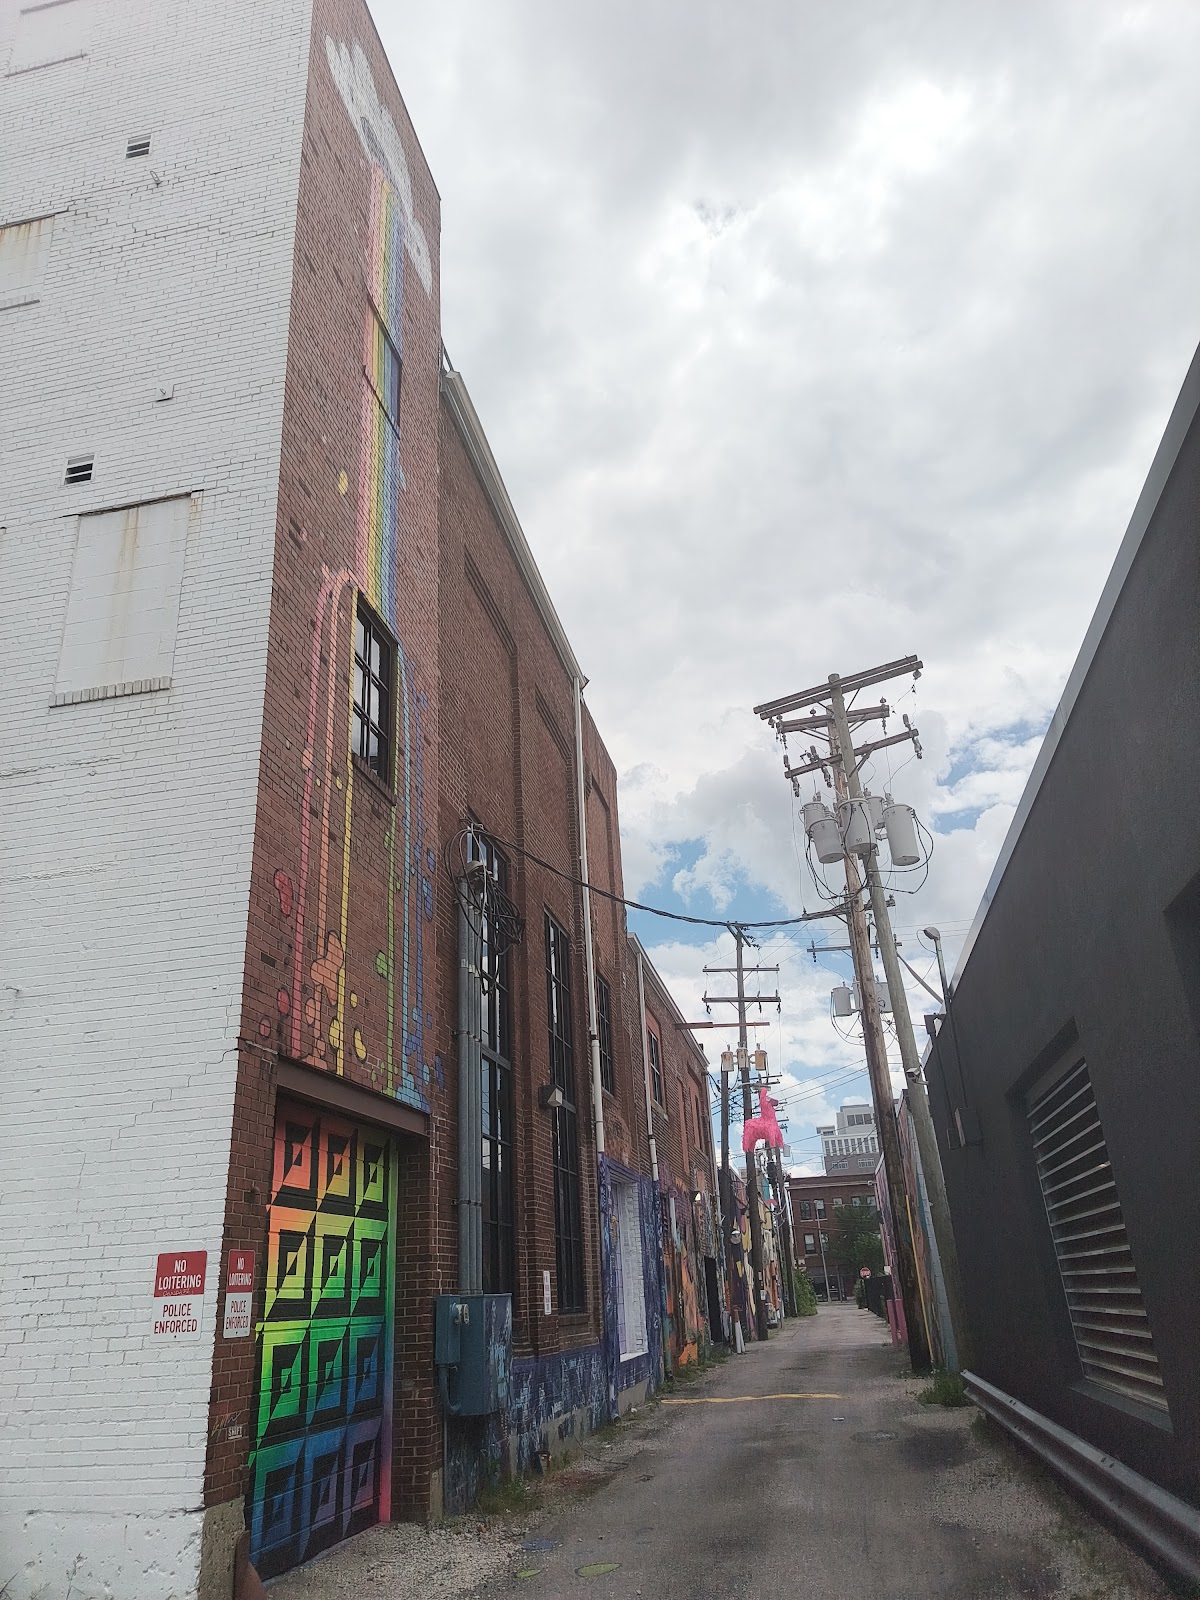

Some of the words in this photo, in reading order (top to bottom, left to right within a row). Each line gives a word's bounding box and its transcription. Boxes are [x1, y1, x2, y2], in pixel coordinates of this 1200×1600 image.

[174, 1260, 186, 1273] NO
[237, 1258, 244, 1270] NO
[158, 1275, 202, 1290] LOITERING
[228, 1273, 252, 1286] LOITERING
[162, 1303, 192, 1317] POLICE
[230, 1300, 247, 1313] POLICE
[153, 1319, 198, 1334] ENFORCED
[225, 1316, 249, 1330] ENFORCED
